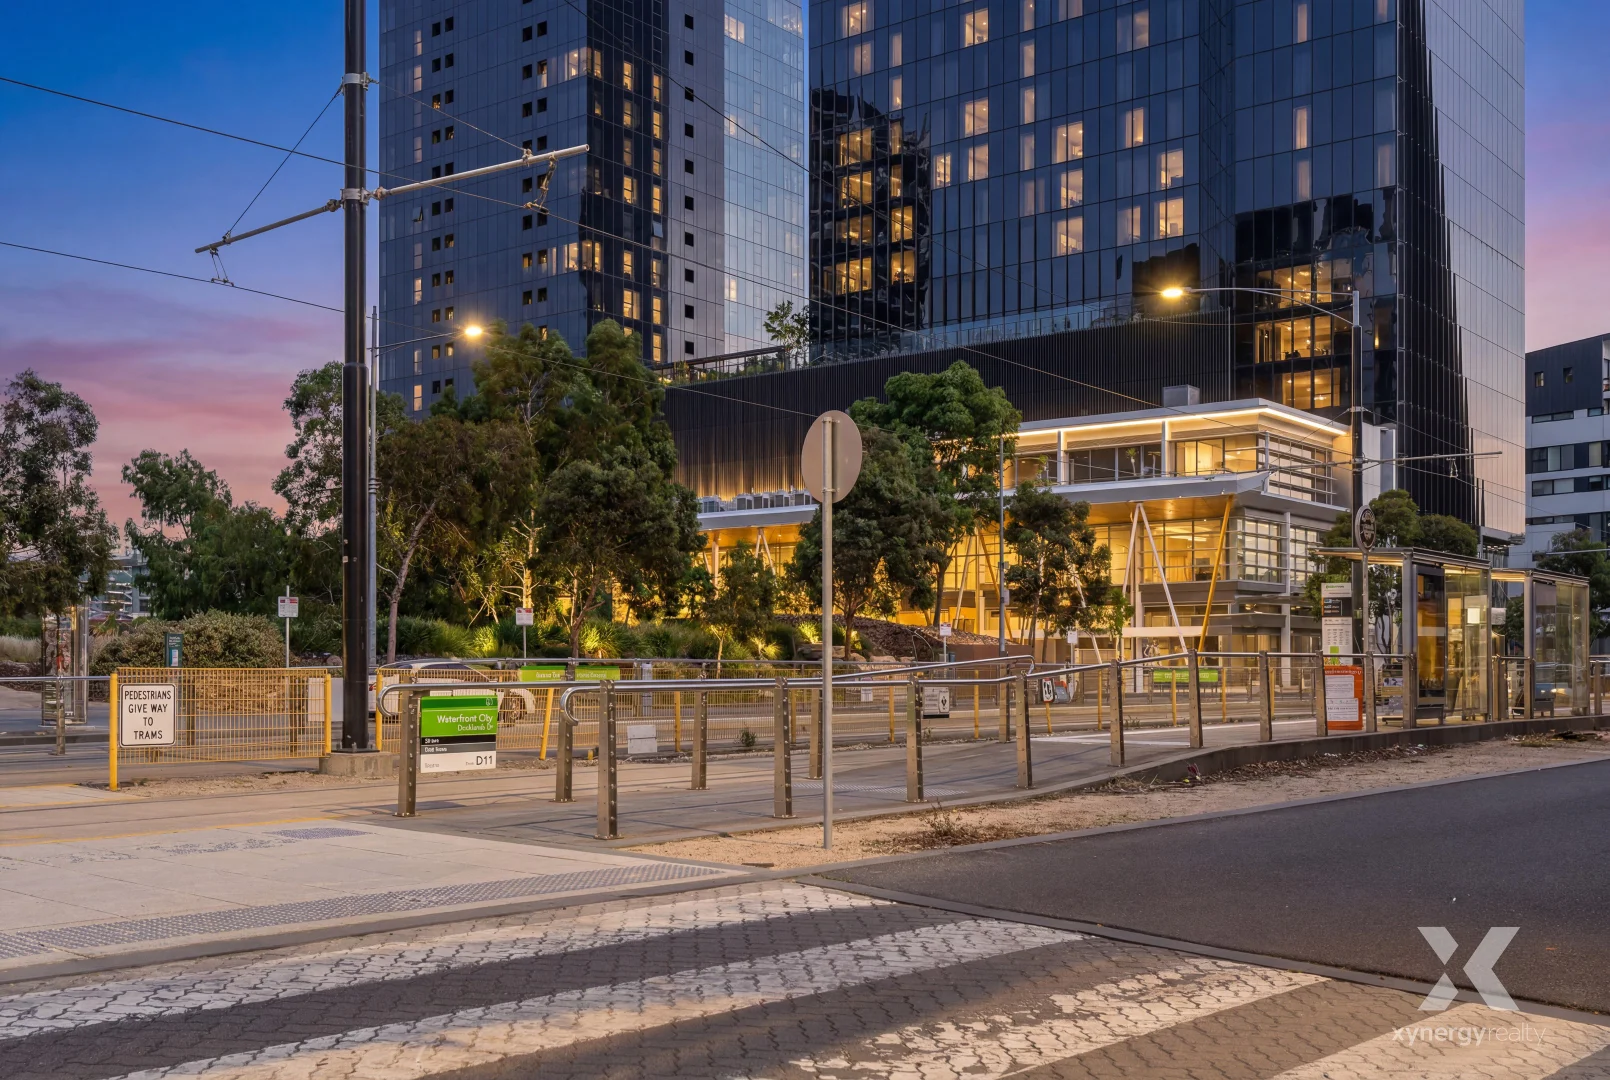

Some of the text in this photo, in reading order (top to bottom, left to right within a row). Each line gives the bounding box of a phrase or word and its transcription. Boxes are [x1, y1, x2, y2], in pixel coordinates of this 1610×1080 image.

[124, 690, 172, 700] PEDESTRIANS
[128, 703, 168, 714] GIVE WAY
[142, 716, 154, 727] TO
[436, 714, 477, 723] Waterfront
[133, 730, 163, 740] TRAMS
[476, 755, 493, 766] D11
